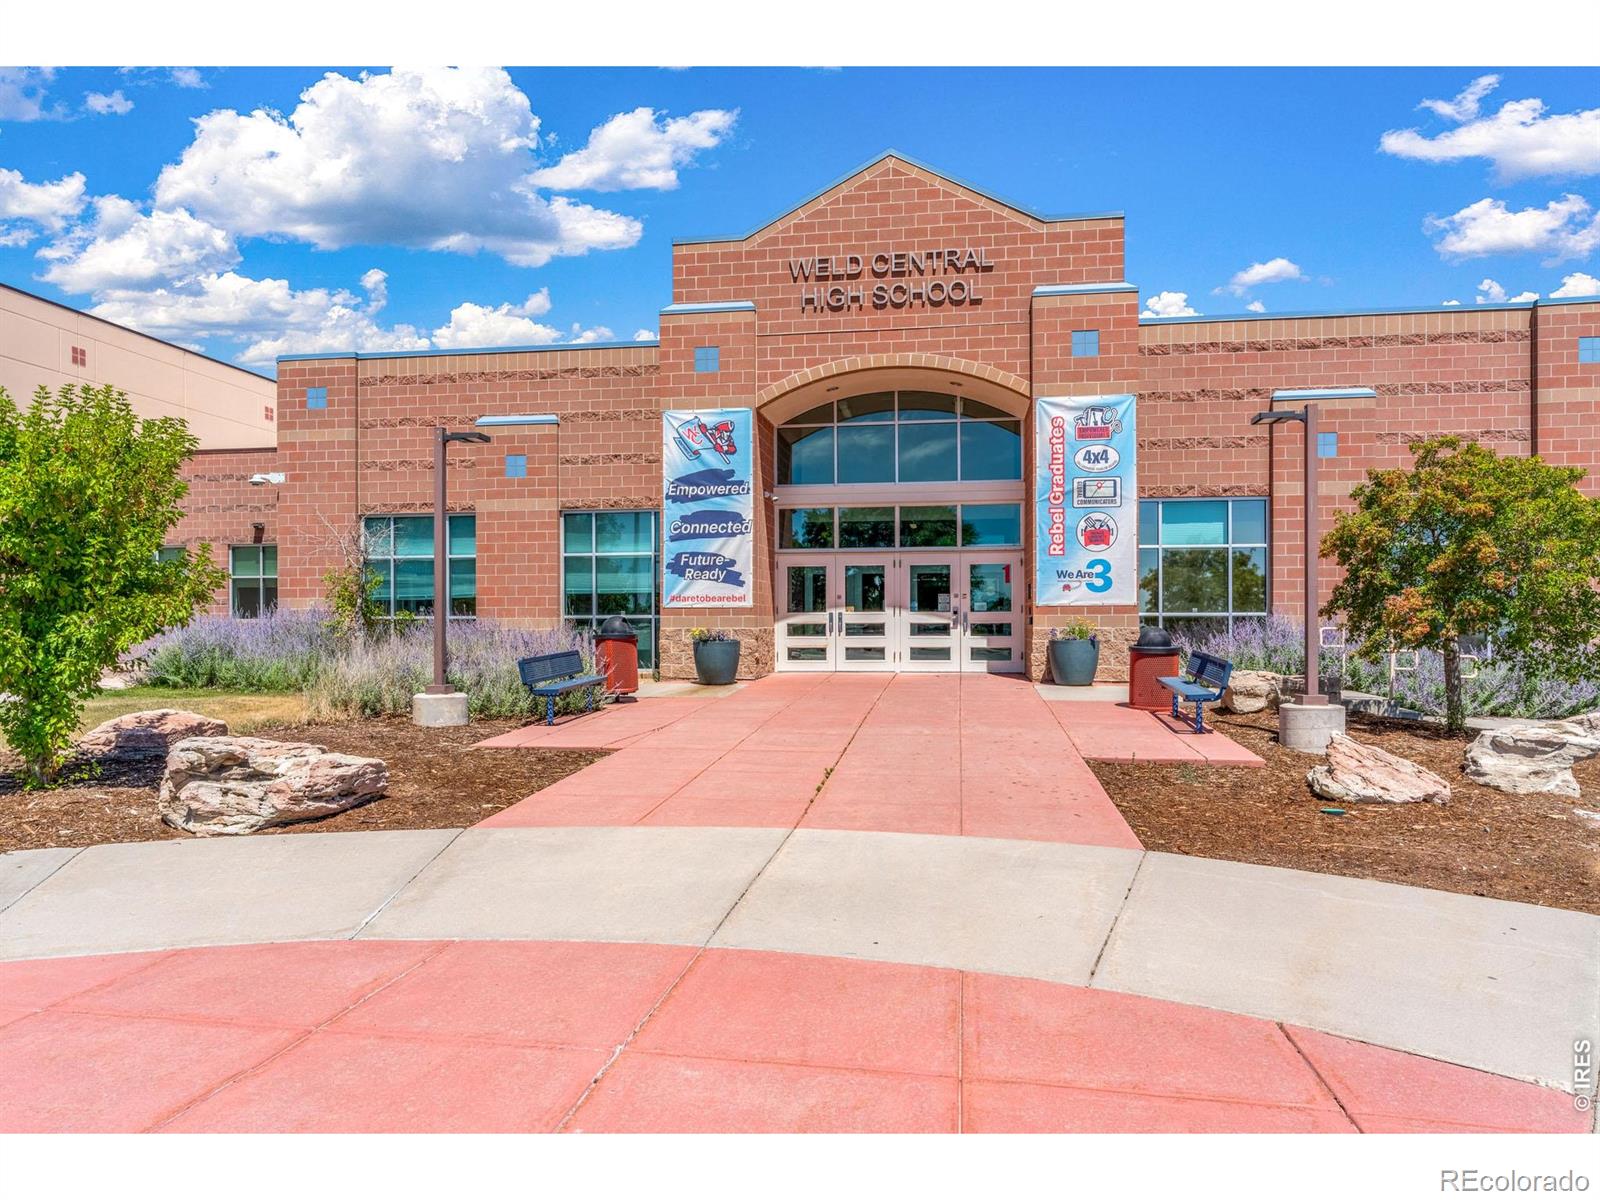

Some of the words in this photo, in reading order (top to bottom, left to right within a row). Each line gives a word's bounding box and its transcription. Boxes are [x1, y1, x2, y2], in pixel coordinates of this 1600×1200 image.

[789, 255, 863, 279] WELD
[872, 247, 994, 275] CENTRAL
[801, 285, 863, 309] HIGH
[872, 280, 983, 306] SCHOOL
[1049, 416, 1064, 505] Graduates
[1083, 449, 1109, 464] 4x4
[668, 482, 749, 498] Empowered
[670, 519, 752, 534] Connected
[1049, 507, 1064, 556] Rebel
[680, 554, 729, 566] Future-
[684, 568, 727, 582] Ready
[1002, 564, 1011, 583] 1
[1056, 569, 1075, 579] We
[1075, 569, 1094, 579] Are
[1085, 558, 1113, 593] 3
[669, 593, 747, 603] #daretobearebel
